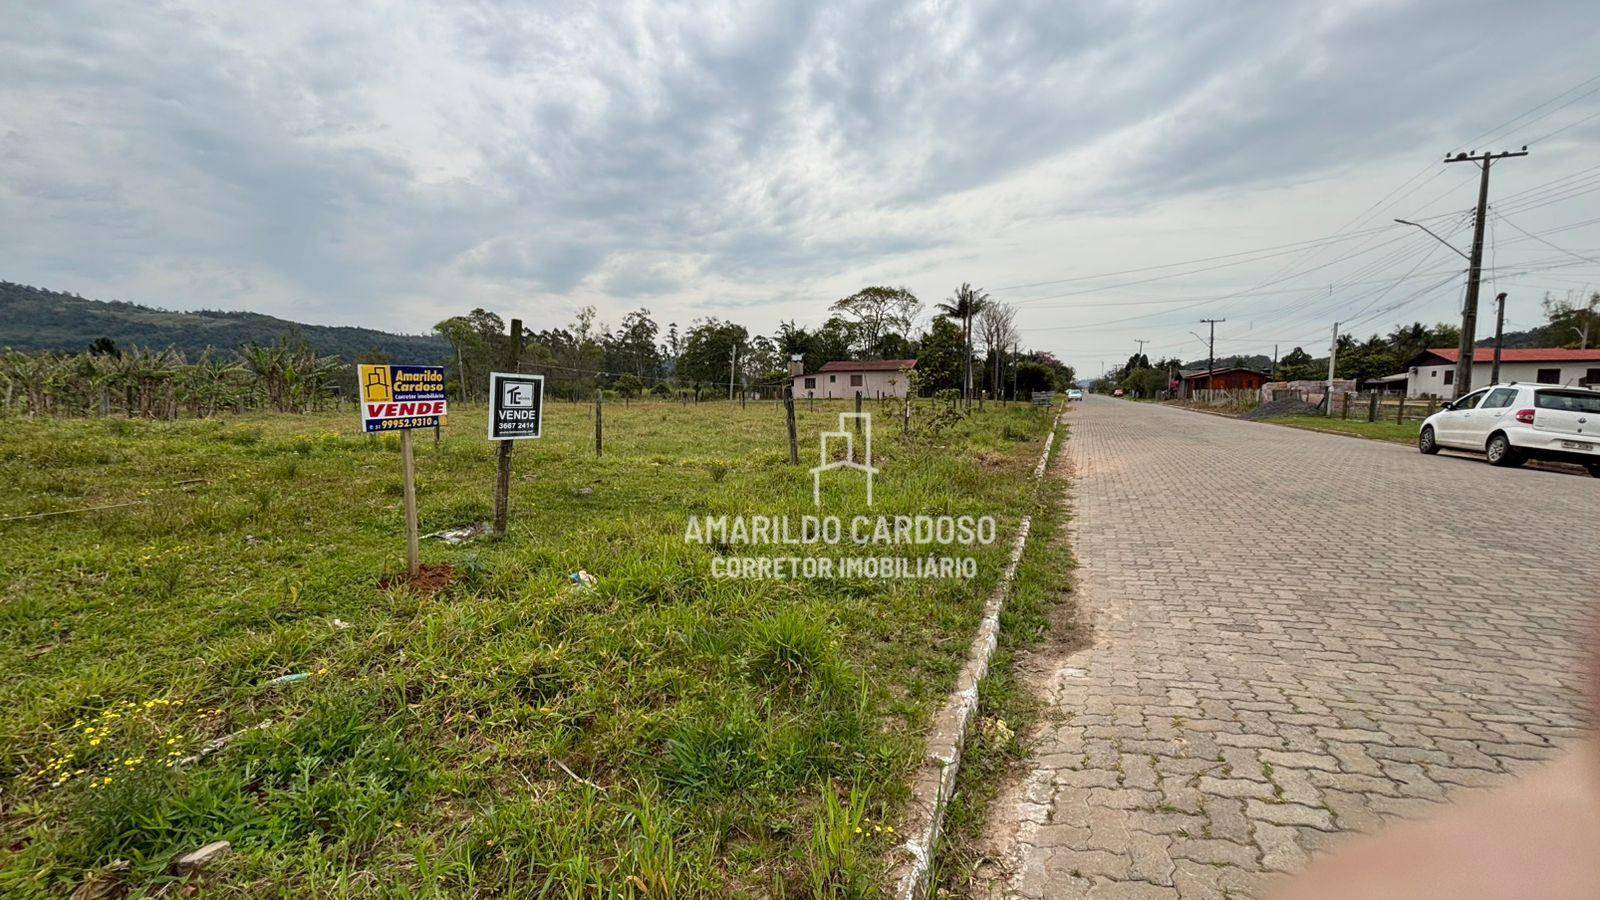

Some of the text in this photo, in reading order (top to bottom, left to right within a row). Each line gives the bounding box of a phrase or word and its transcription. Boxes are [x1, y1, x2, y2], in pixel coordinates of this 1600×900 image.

[395, 370, 443, 381] Amarildo
[393, 381, 444, 391] Cardoso
[367, 402, 444, 418] VENDE
[498, 410, 536, 420] VENDE
[381, 417, 433, 429] 99952.9310
